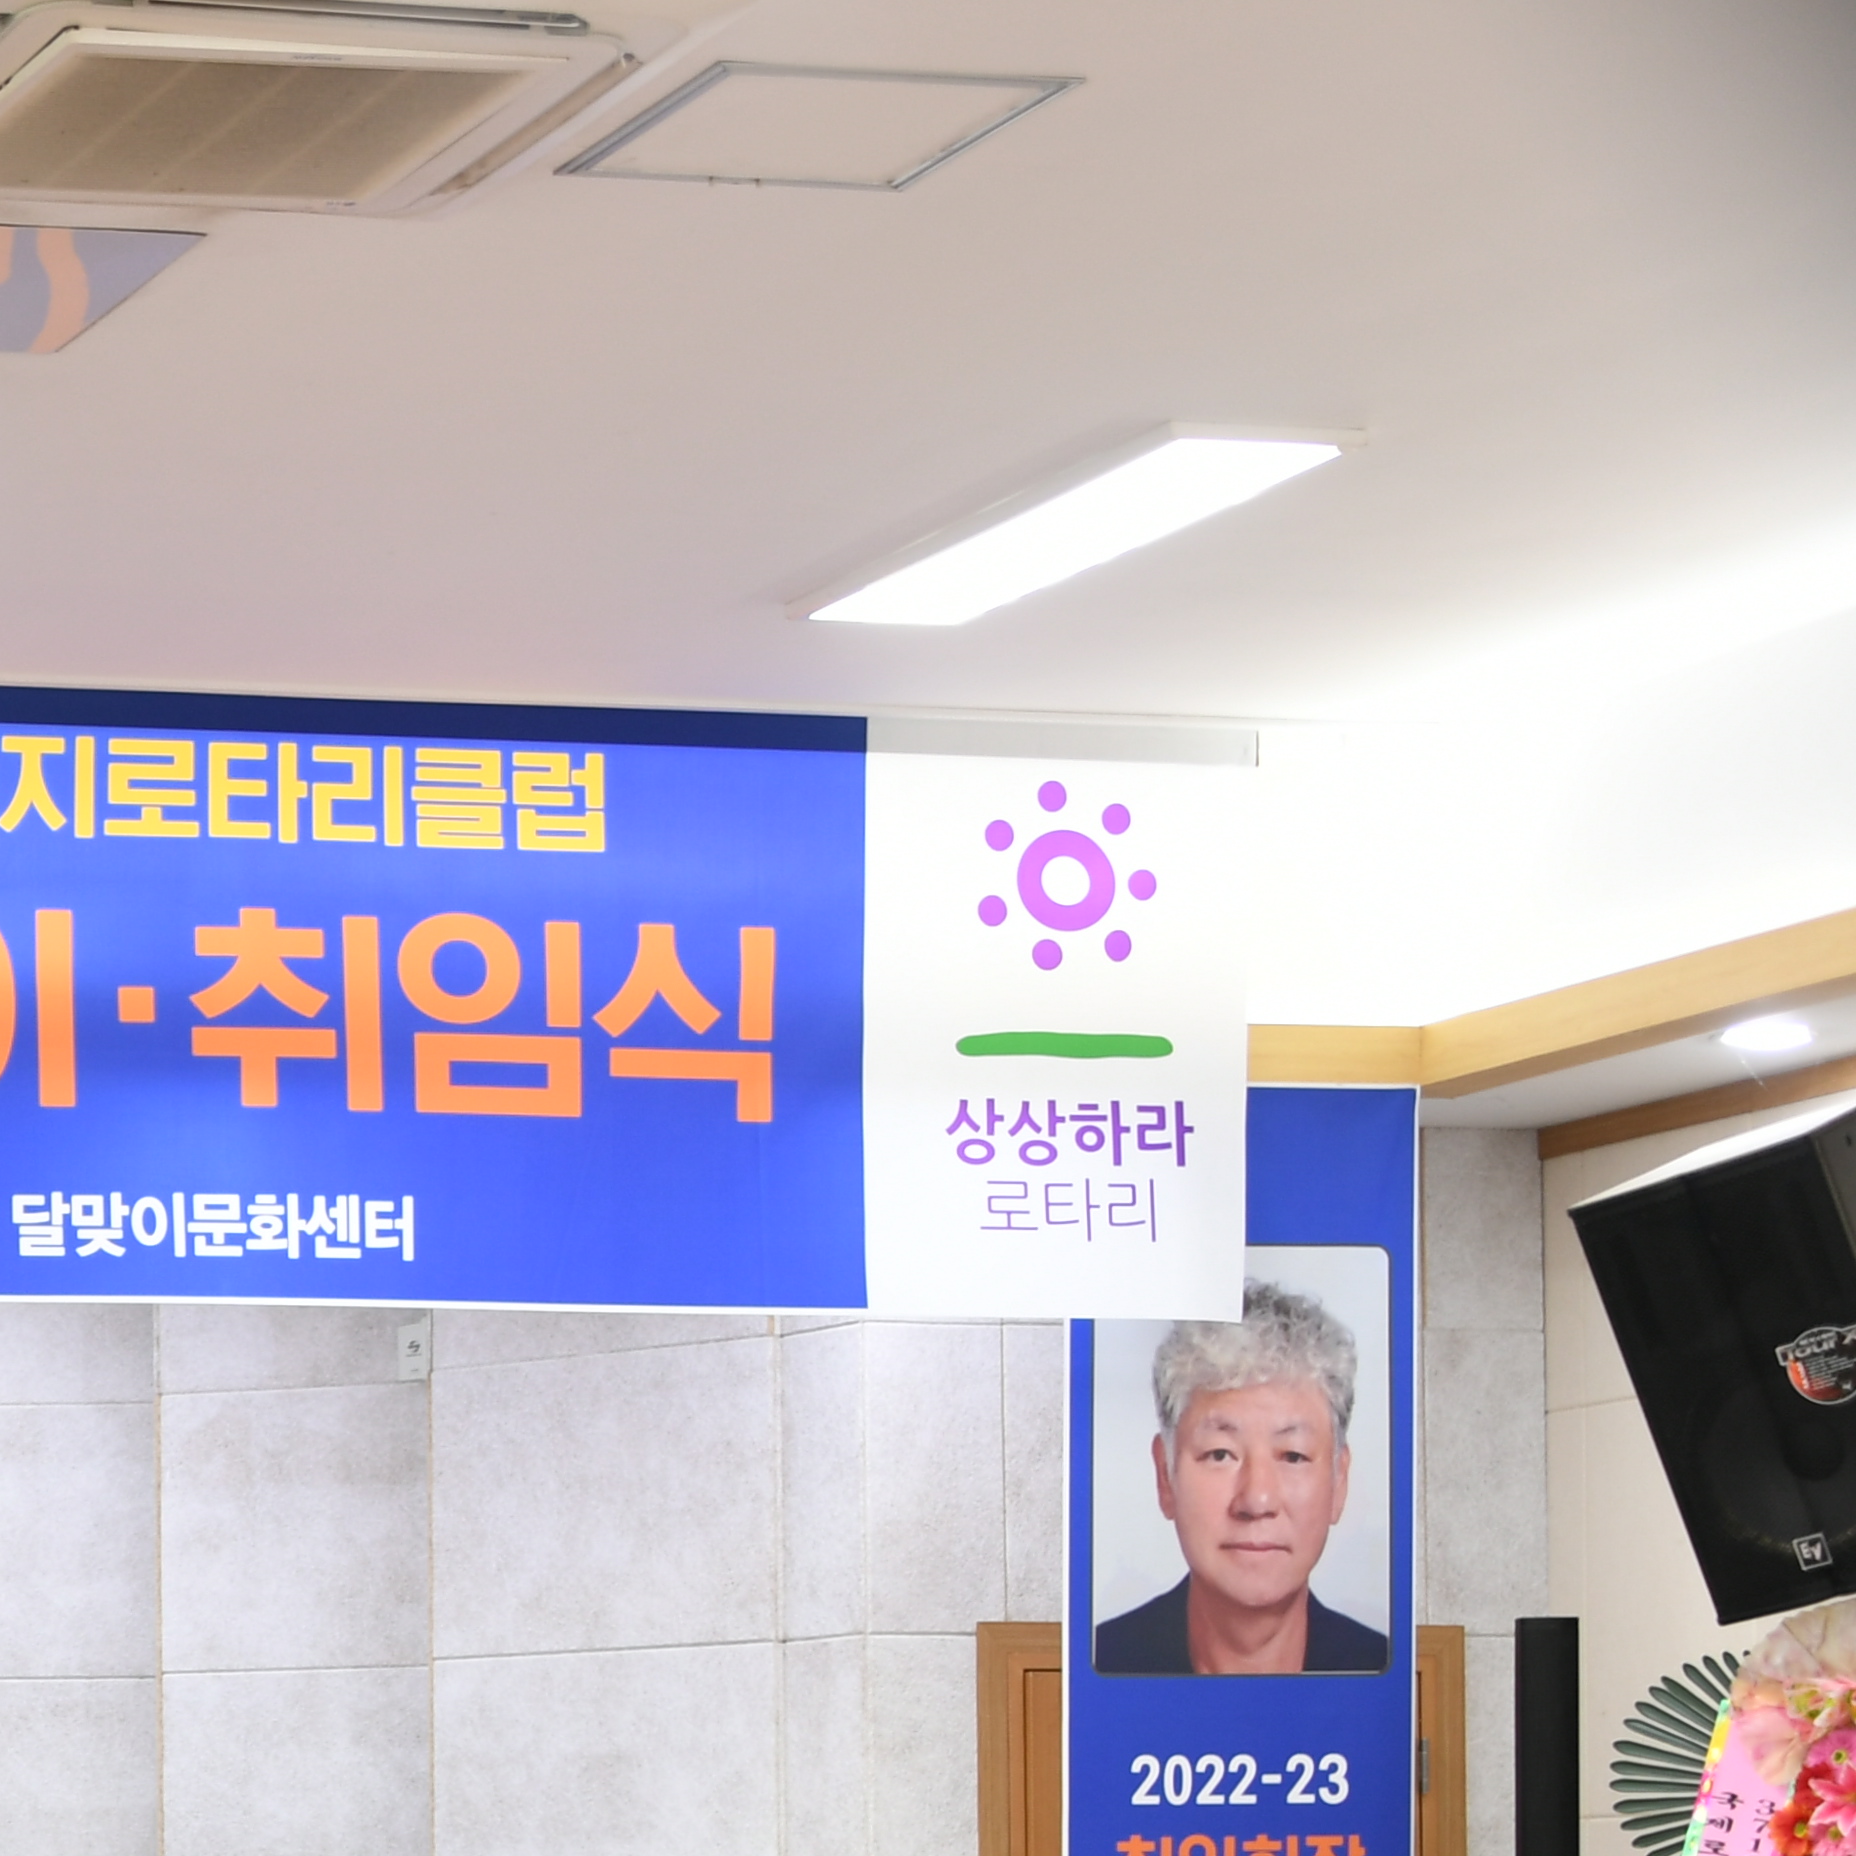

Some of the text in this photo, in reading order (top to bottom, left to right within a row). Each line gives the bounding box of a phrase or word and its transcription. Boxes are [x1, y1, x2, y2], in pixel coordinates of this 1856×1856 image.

[945, 1098, 1194, 1167] 상상하라
[12, 1191, 415, 1262] 달맞이문화센터
[980, 1178, 1156, 1242] 로타리
[1130, 1754, 1350, 1806] 2022-23
